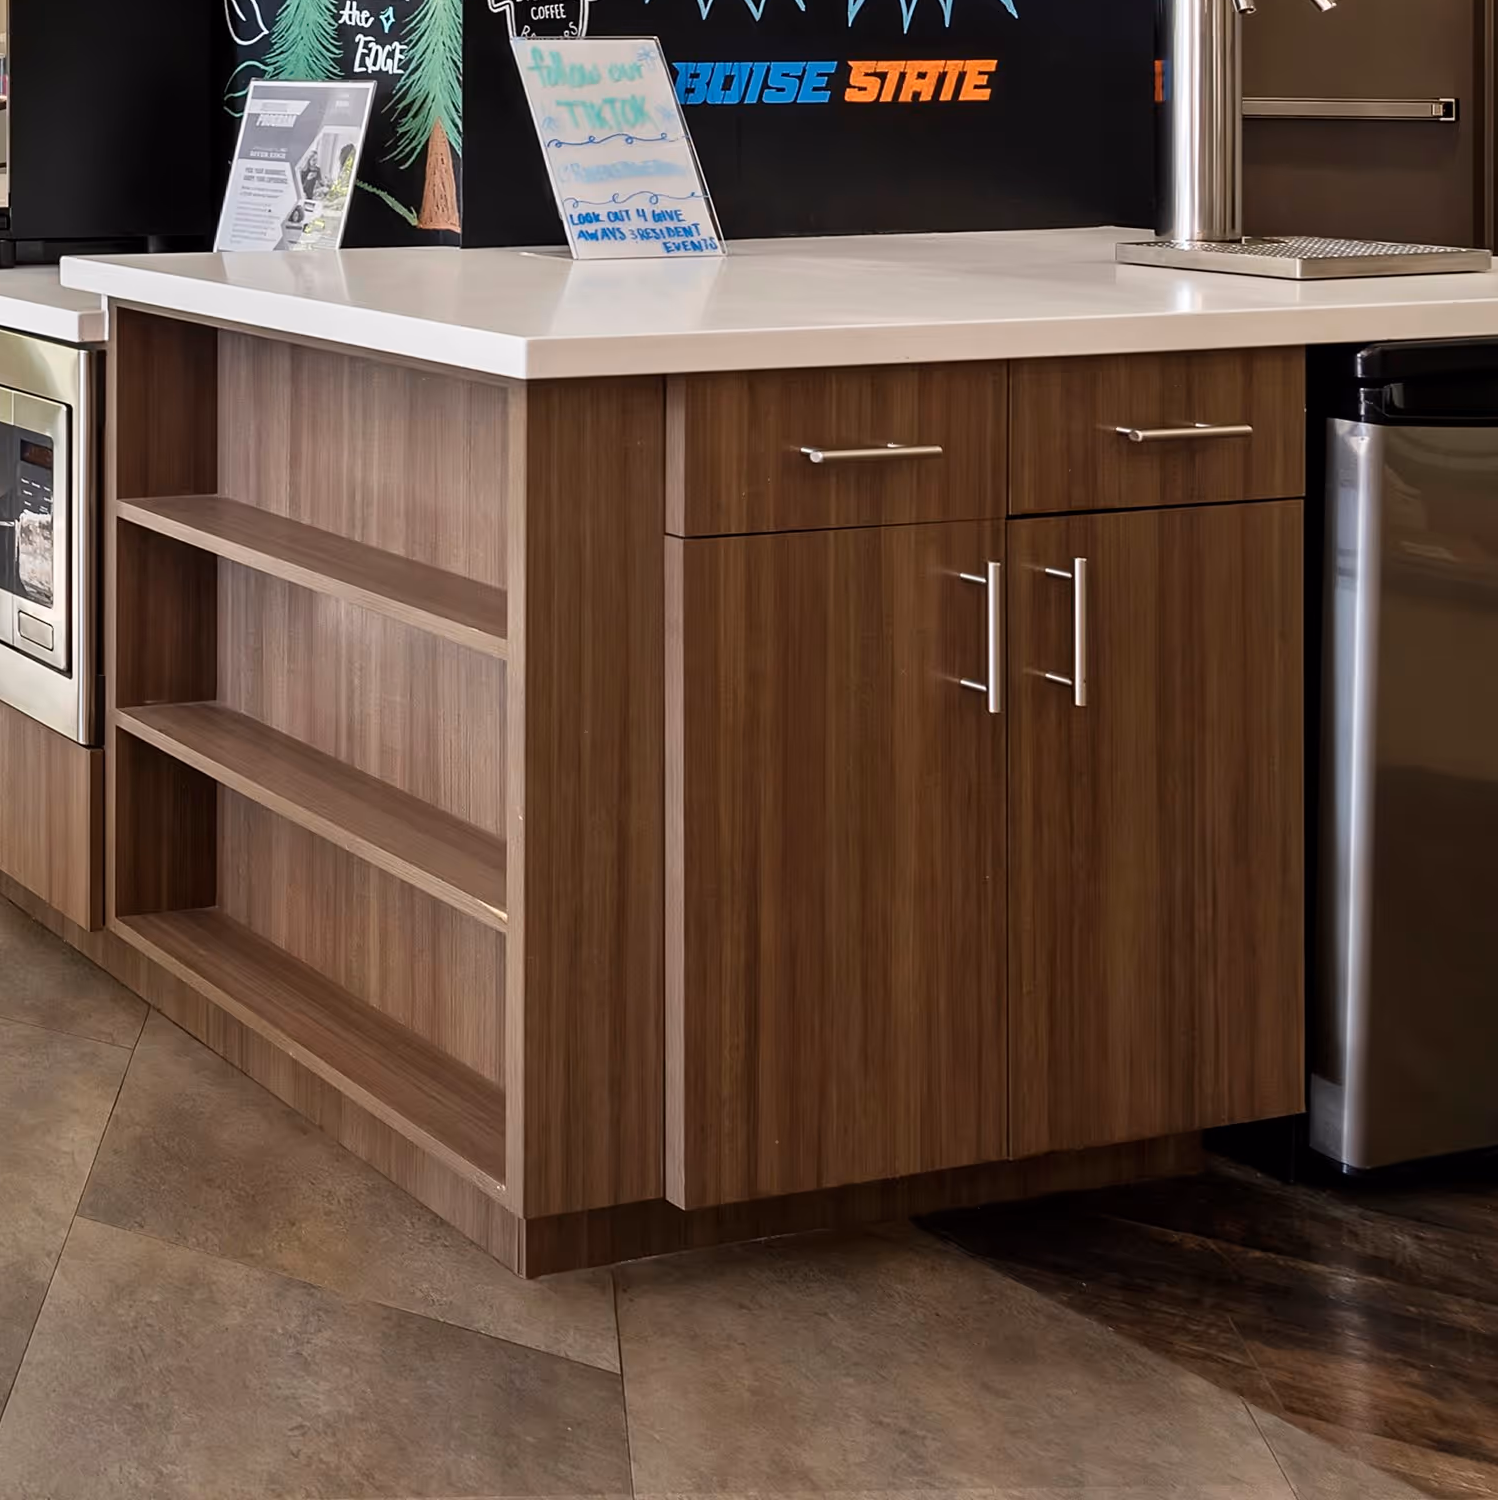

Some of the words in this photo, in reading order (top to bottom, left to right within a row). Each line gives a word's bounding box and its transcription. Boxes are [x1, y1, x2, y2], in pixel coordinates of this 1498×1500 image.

[338, 1, 375, 28] the
[531, 3, 567, 20] COFFEE
[353, 34, 407, 75] EDGE
[672, 60, 838, 105] BOISE
[843, 59, 999, 102] STATE
[569, 212, 605, 226] LOOK
[607, 209, 631, 223] OUT
[636, 208, 647, 222] 4
[652, 209, 685, 223] GIVE
[637, 223, 701, 241] RESIDENT
[663, 237, 718, 253] EVENTS
